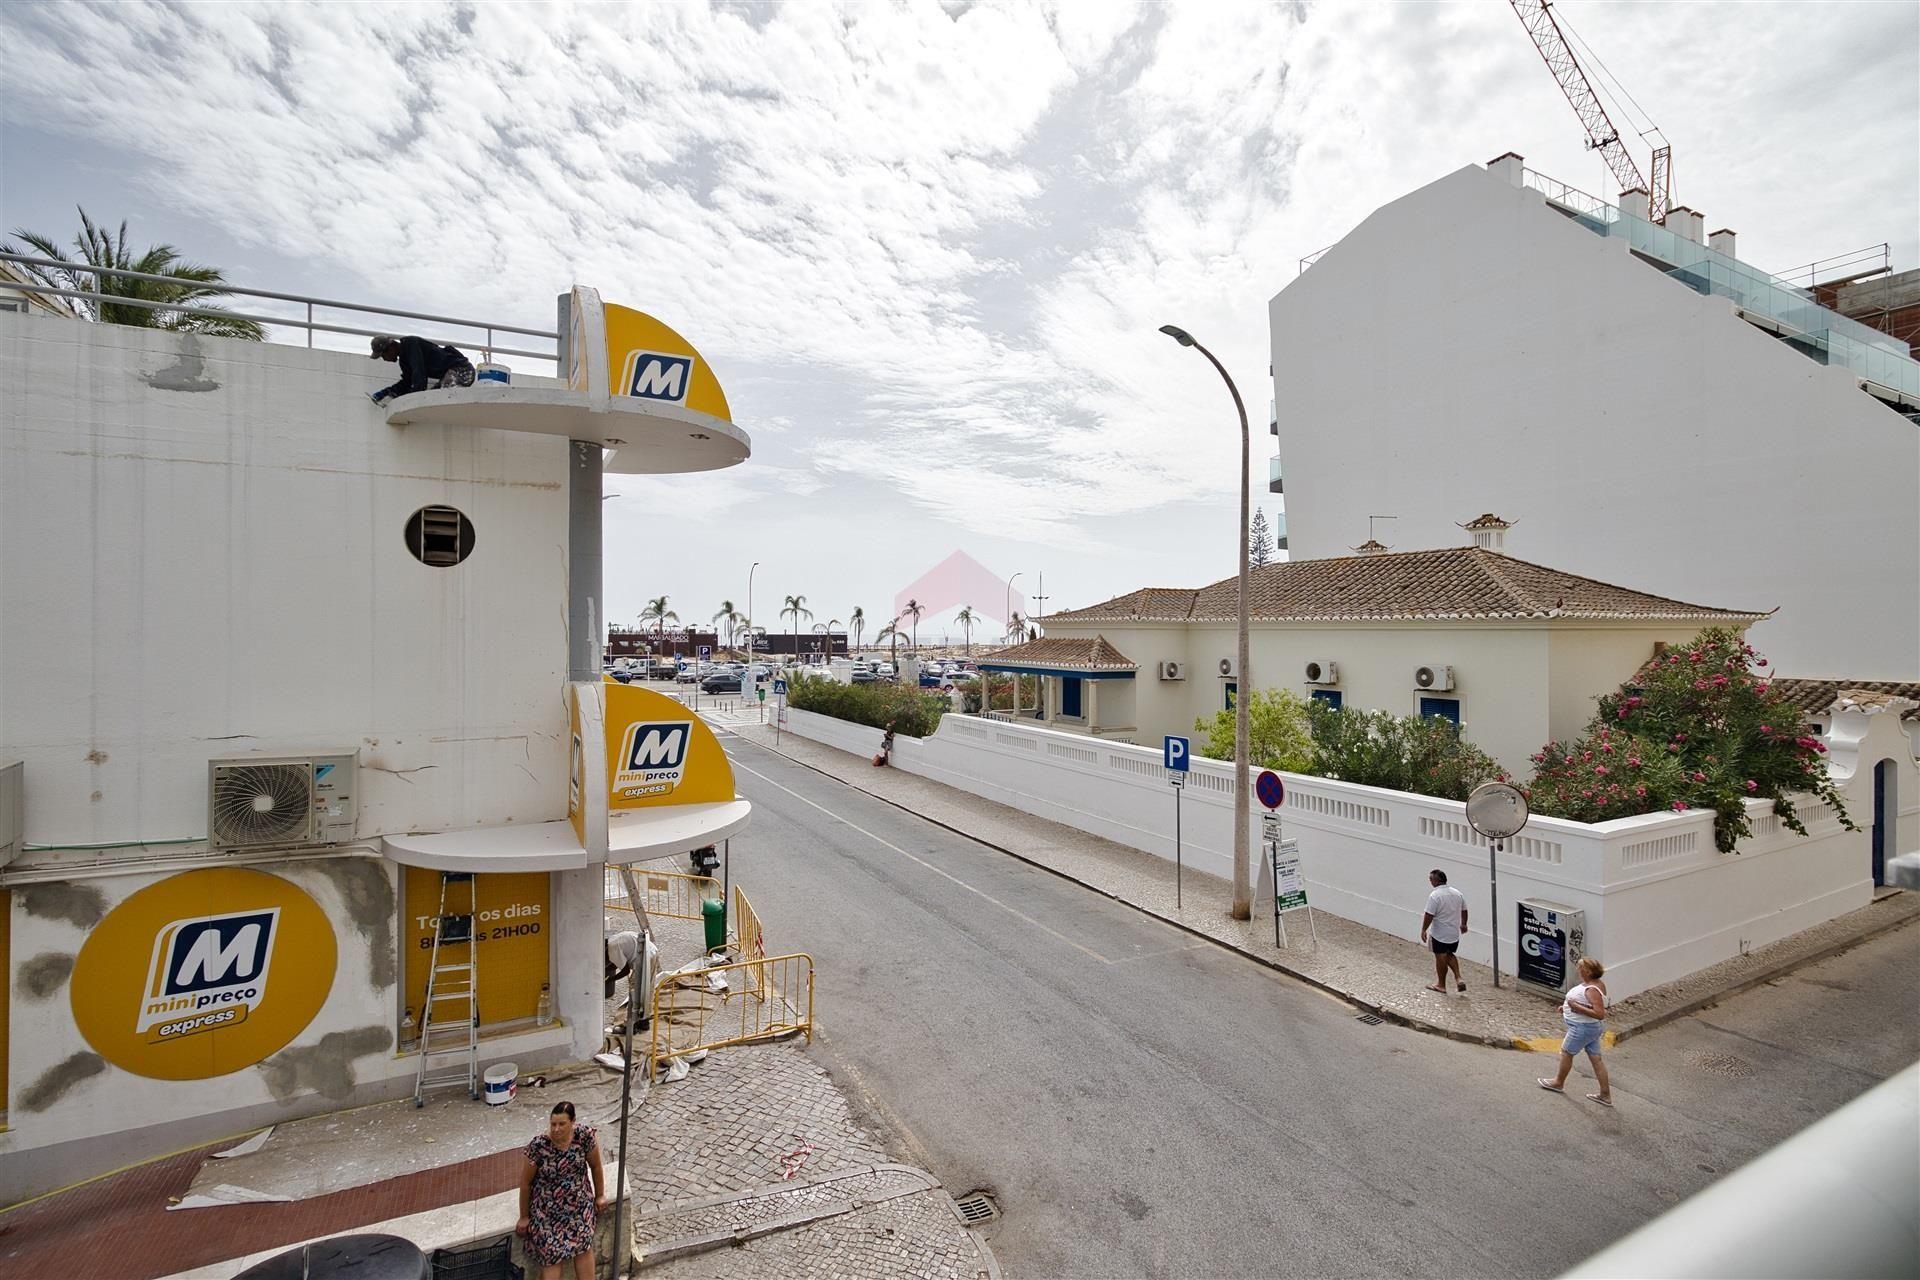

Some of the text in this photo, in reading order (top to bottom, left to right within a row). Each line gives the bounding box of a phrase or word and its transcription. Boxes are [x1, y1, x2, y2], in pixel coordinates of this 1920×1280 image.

[636, 359, 684, 397] M
[634, 729, 683, 765] M
[1169, 738, 1184, 767] P
[618, 770, 679, 782] minipreço
[624, 784, 667, 798] express
[479, 909, 500, 922] os
[504, 903, 541, 919] dias
[1523, 917, 1540, 926] esta
[492, 922, 541, 940] 21H00
[1523, 923, 1558, 938] tem fibra
[175, 923, 261, 986] M
[147, 988, 257, 1014] minipreço
[158, 1008, 236, 1037] express
